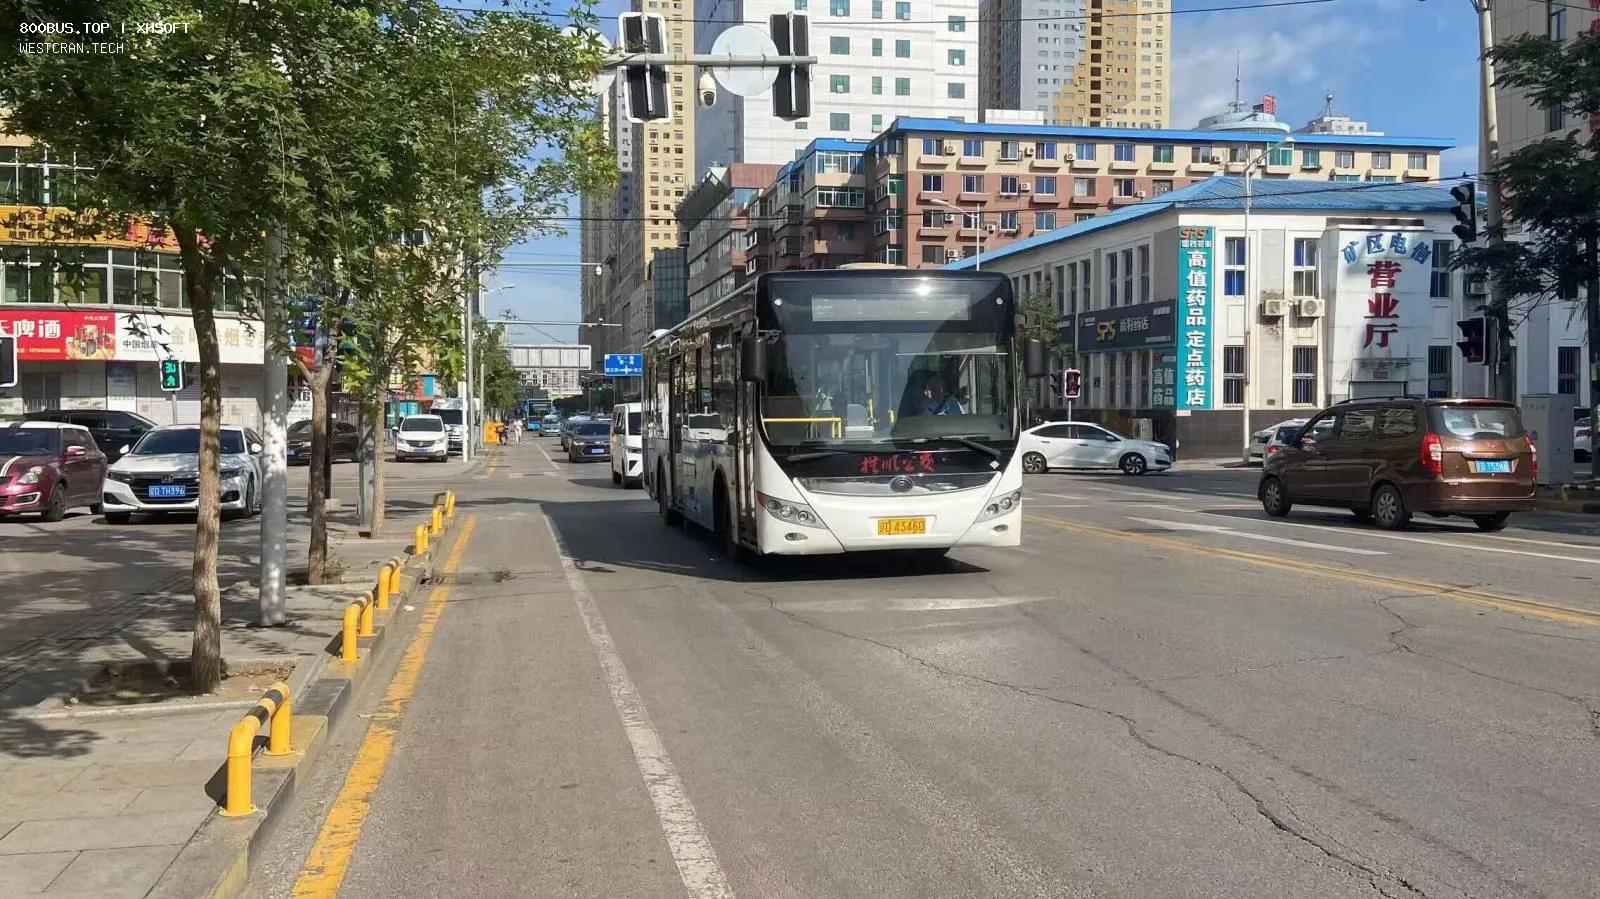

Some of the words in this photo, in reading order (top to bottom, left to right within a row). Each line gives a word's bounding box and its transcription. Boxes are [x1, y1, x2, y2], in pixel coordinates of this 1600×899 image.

[1341, 232, 1432, 265] 矿区电信
[1363, 260, 1401, 349] 营业厅
